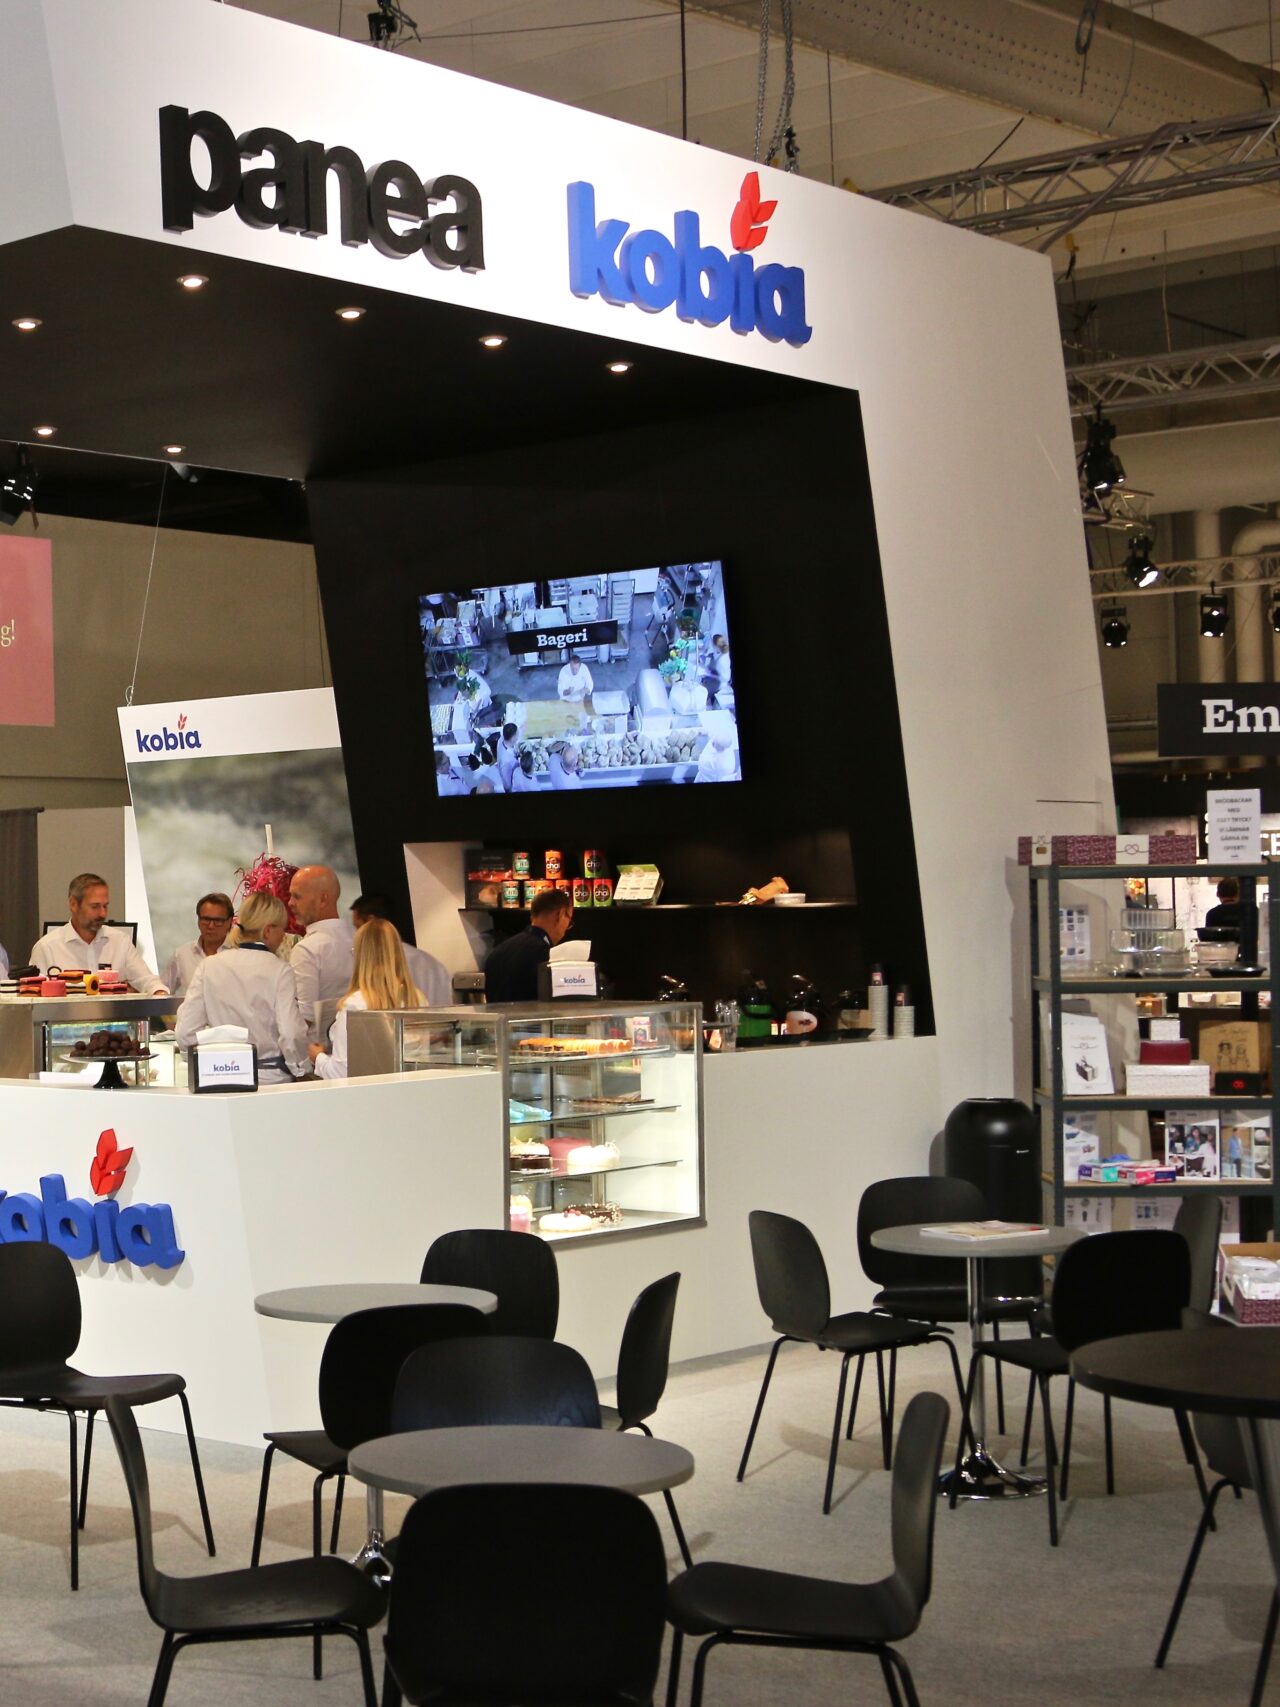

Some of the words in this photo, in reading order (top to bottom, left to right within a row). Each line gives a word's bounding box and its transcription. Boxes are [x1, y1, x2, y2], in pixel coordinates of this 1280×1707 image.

[159, 104, 486, 274] panea
[566, 178, 813, 347] kobia
[536, 628, 588, 648] Bageri
[136, 725, 202, 753] kobia
[213, 1063, 241, 1072] kobia
